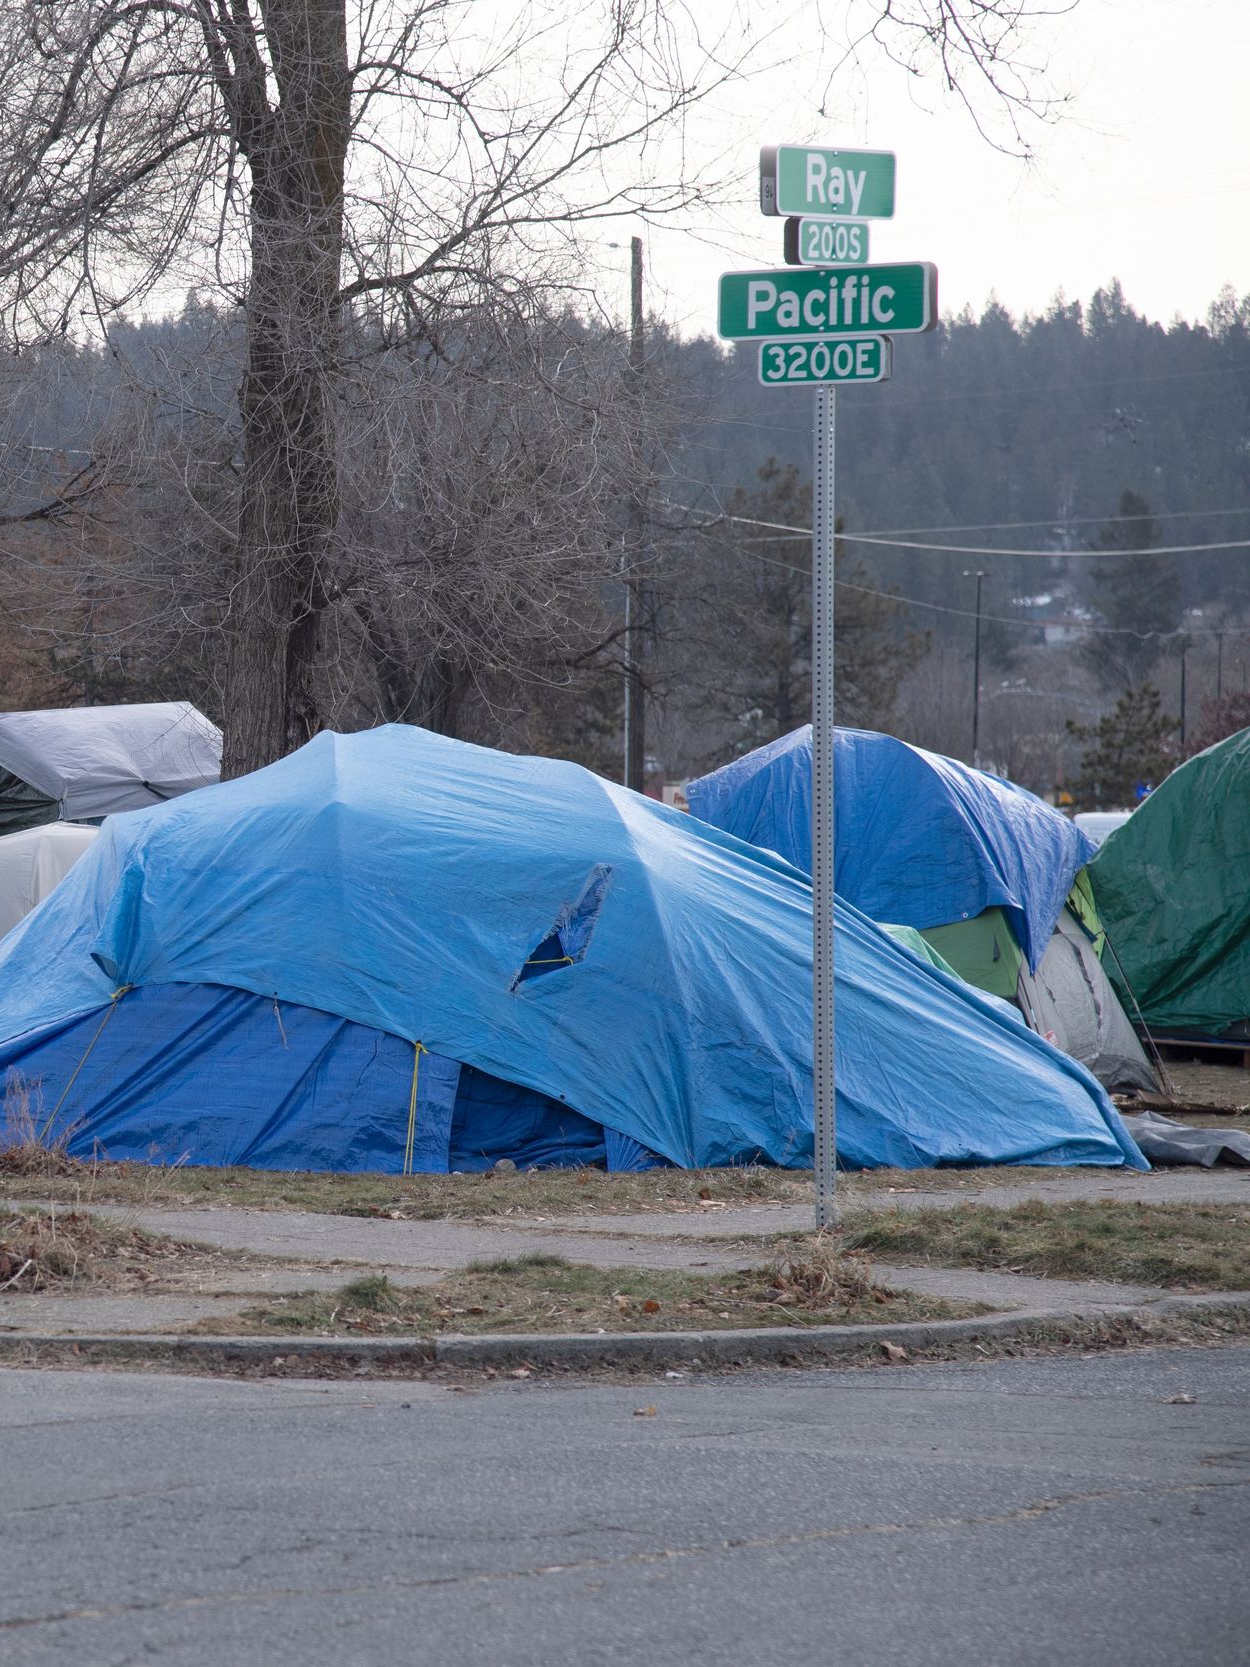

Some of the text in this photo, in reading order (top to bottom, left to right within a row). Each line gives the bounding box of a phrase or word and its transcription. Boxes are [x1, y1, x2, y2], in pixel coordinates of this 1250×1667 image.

[806, 153, 867, 215] Ray
[808, 224, 861, 260] 200S
[747, 275, 896, 330] Pacific
[766, 342, 875, 380] 3200E
